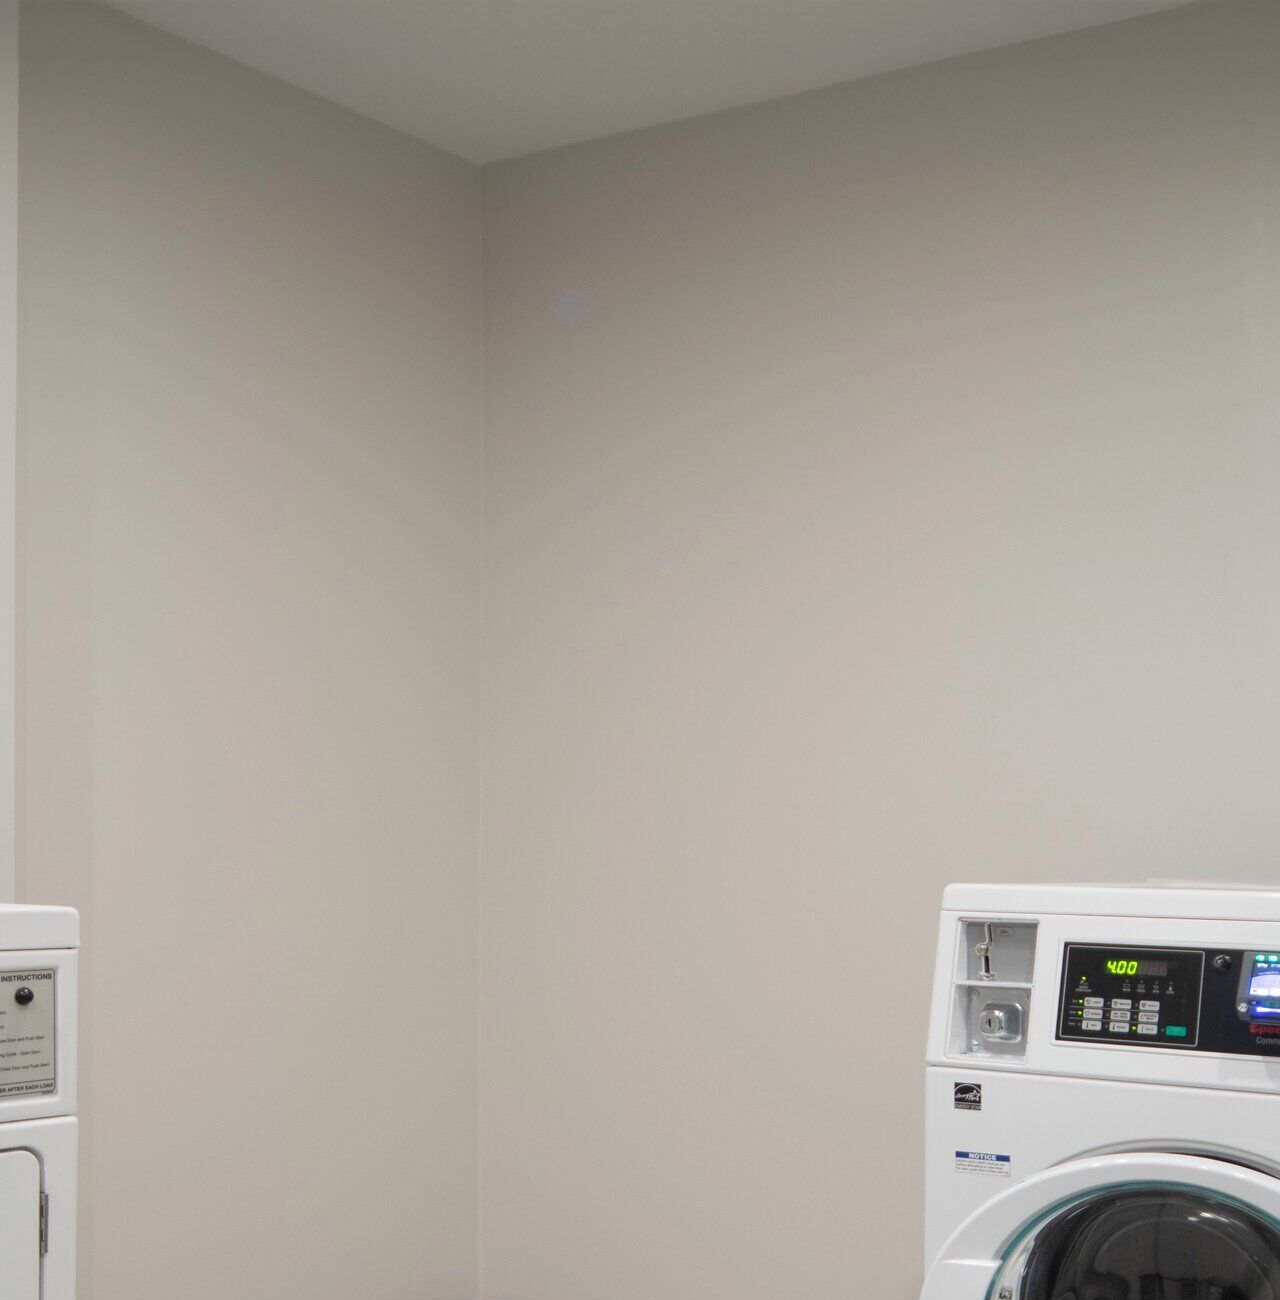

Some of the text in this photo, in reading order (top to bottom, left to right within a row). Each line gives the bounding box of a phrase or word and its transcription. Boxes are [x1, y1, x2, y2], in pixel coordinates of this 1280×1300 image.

[1107, 960, 1138, 974] 4.00
[1, 973, 52, 982] INSTRUCTIONS
[969, 1152, 997, 1161] NOTICE
